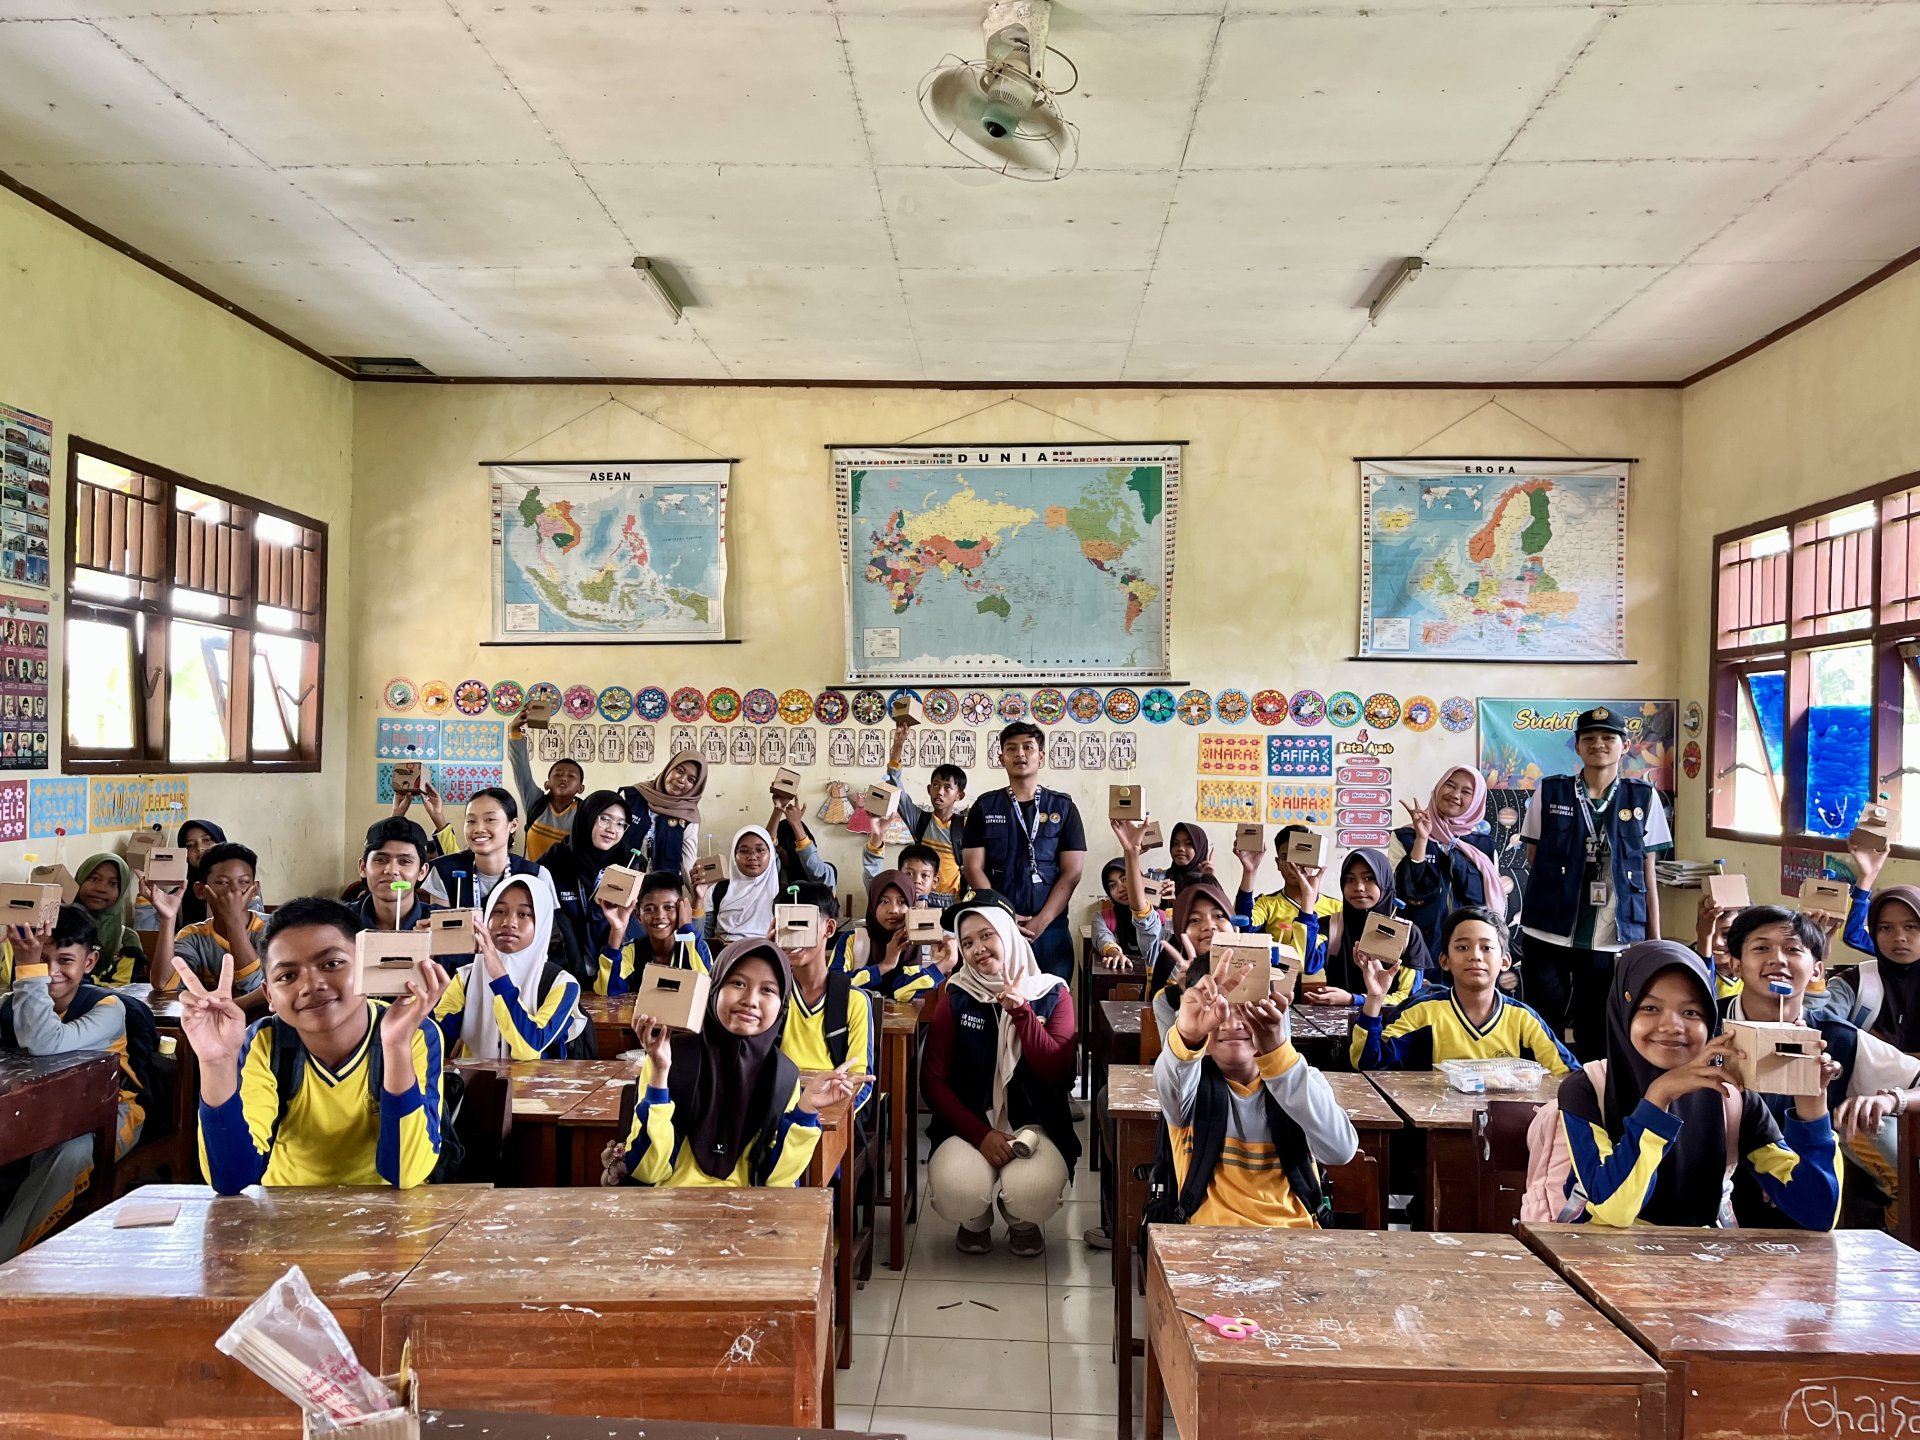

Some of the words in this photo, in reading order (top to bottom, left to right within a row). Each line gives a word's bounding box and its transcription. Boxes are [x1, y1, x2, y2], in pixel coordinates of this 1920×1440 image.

[957, 452, 1048, 463] DUNIA
[1465, 465, 1516, 474] EROPA
[590, 471, 631, 482] ASEAN
[1513, 708, 1580, 731] Sudut
[955, 735, 971, 744] Nya
[1116, 737, 1131, 745] Nga
[1357, 729, 1369, 743] 4
[1209, 748, 1252, 760] INARA
[1338, 742, 1364, 754] Kata
[1367, 742, 1394, 756] Ajaib
[1281, 749, 1320, 762] AFIFA
[1283, 796, 1318, 810] AUFA
[0, 801, 25, 820] ELA
